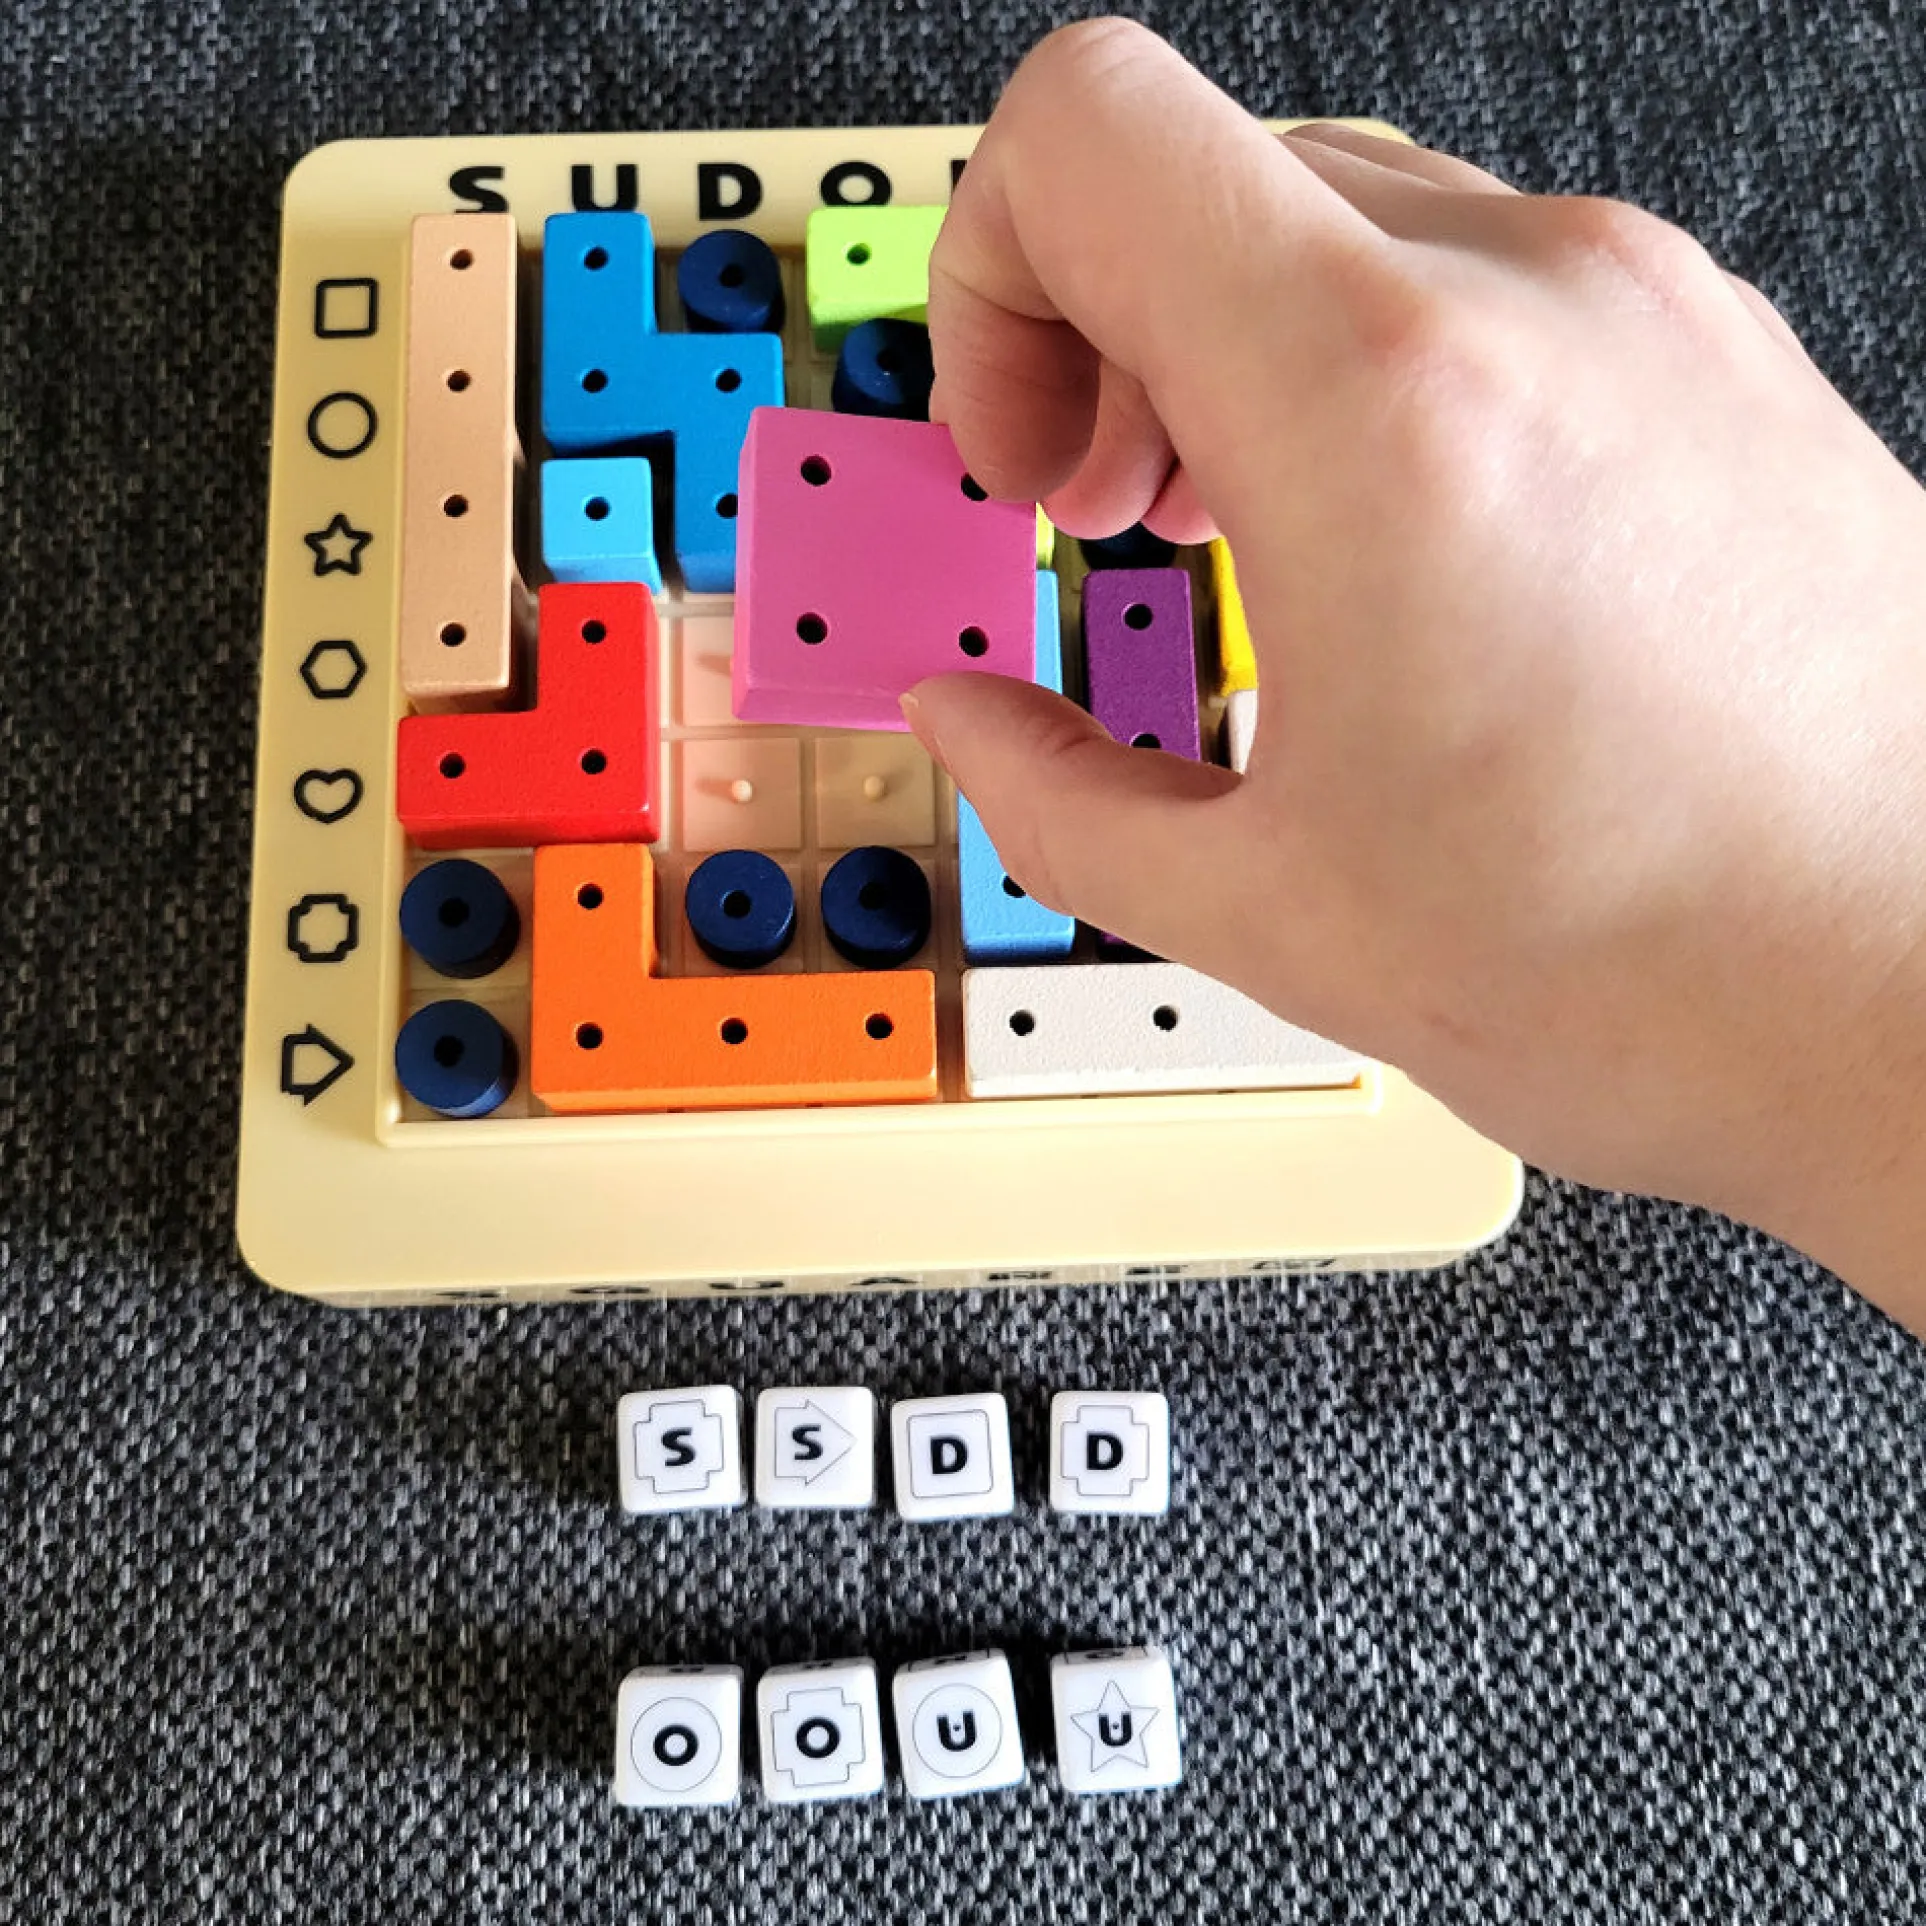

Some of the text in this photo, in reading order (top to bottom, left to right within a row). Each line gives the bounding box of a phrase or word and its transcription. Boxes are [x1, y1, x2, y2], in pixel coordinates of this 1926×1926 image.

[448, 159, 968, 221] SUDO
[660, 1428, 697, 1467] S
[792, 1424, 822, 1461] S
[929, 1435, 968, 1475] D
[1085, 1432, 1124, 1471] D
[652, 1724, 699, 1767] O
[795, 1717, 841, 1759] O
[936, 1711, 977, 1752] U
[1098, 1712, 1133, 1747] U
